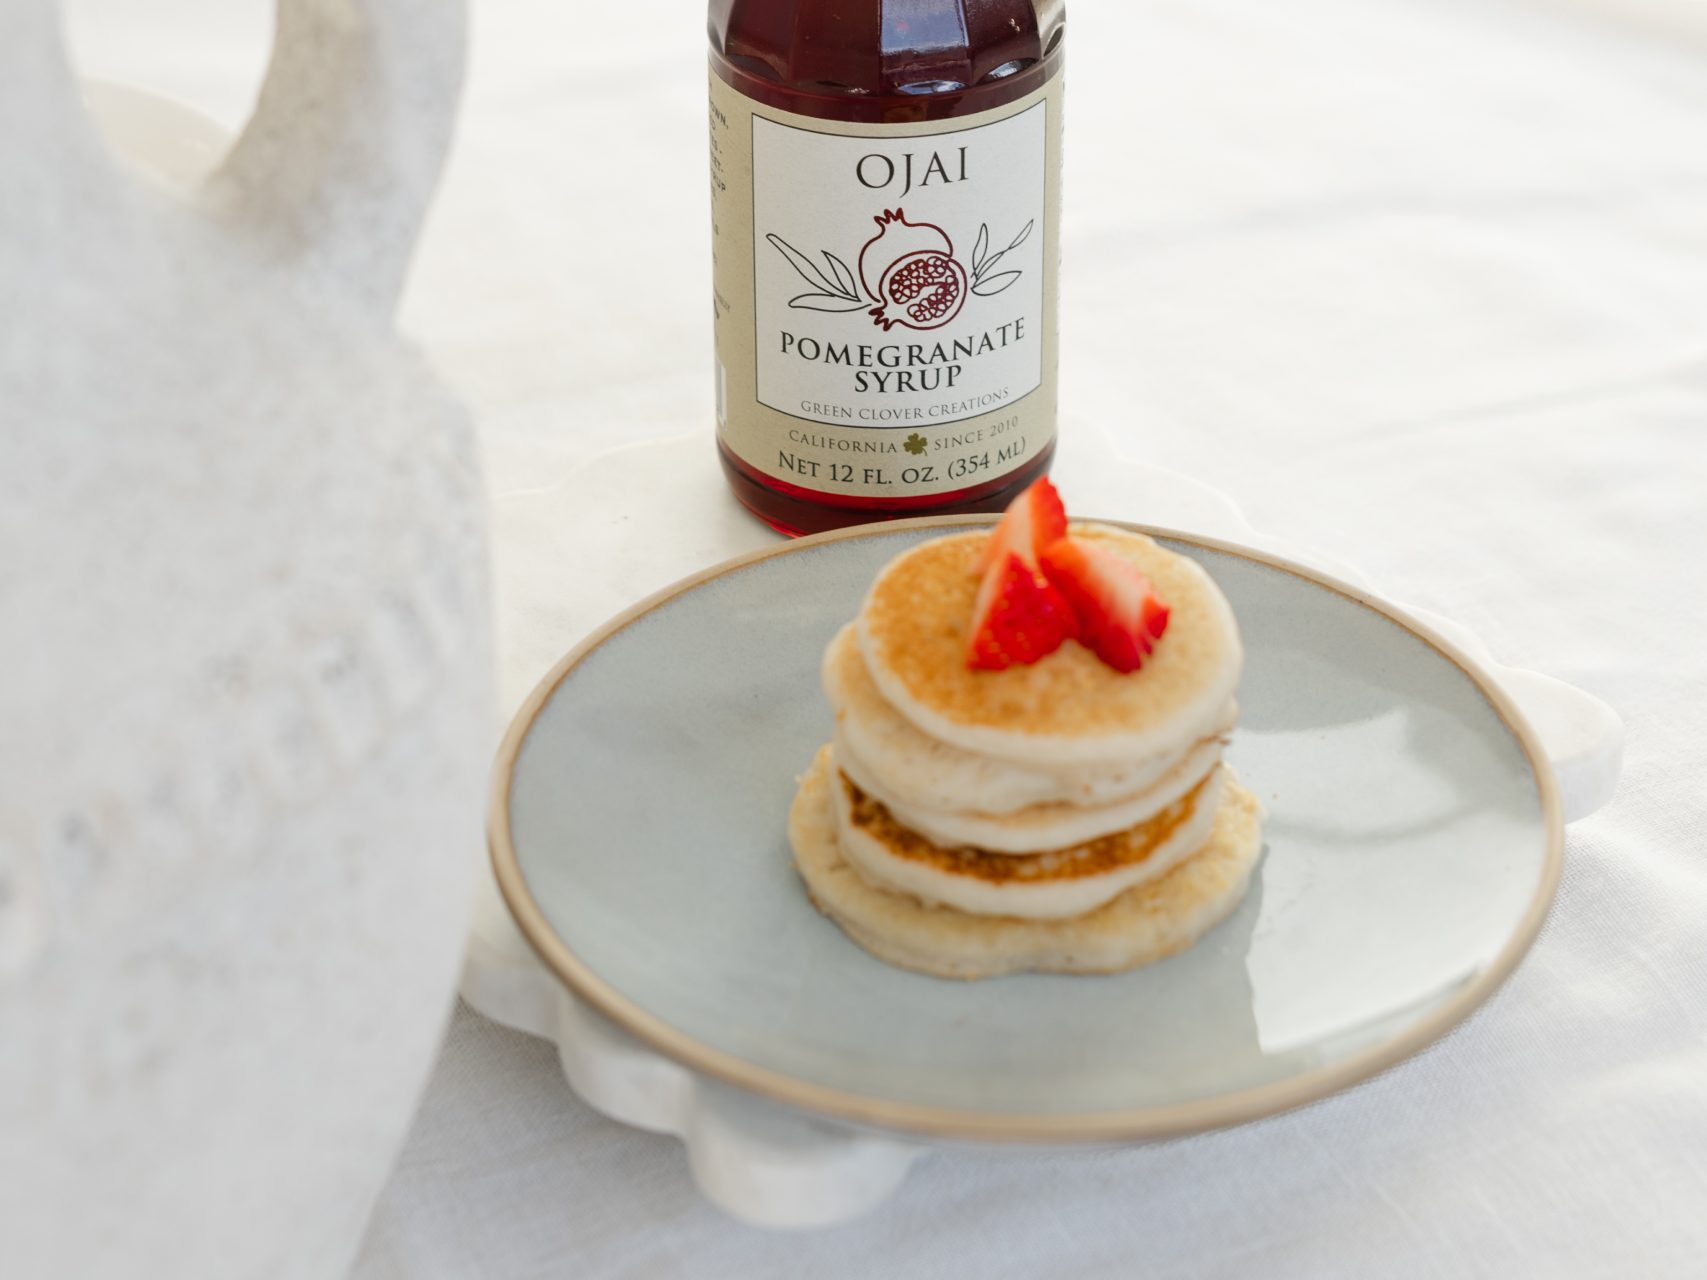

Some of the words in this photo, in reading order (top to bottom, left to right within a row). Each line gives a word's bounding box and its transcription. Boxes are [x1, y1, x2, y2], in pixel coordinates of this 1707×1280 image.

[856, 146, 969, 198] OJAI
[780, 317, 1025, 368] POMEGRANATE
[854, 365, 962, 393] SYRUP
[801, 400, 852, 419] GREEN
[859, 407, 924, 420] CLOVER
[928, 387, 1009, 417] CREATIONS
[789, 430, 897, 453] CALIFORNIA
[934, 431, 983, 451] SINCE
[990, 415, 1018, 437] 2010
[778, 450, 820, 478] NET
[829, 465, 854, 483] 12
[864, 469, 892, 485] FL.
[902, 467, 939, 483] OZ.
[948, 453, 990, 481] (354
[997, 436, 1026, 464] ML)
